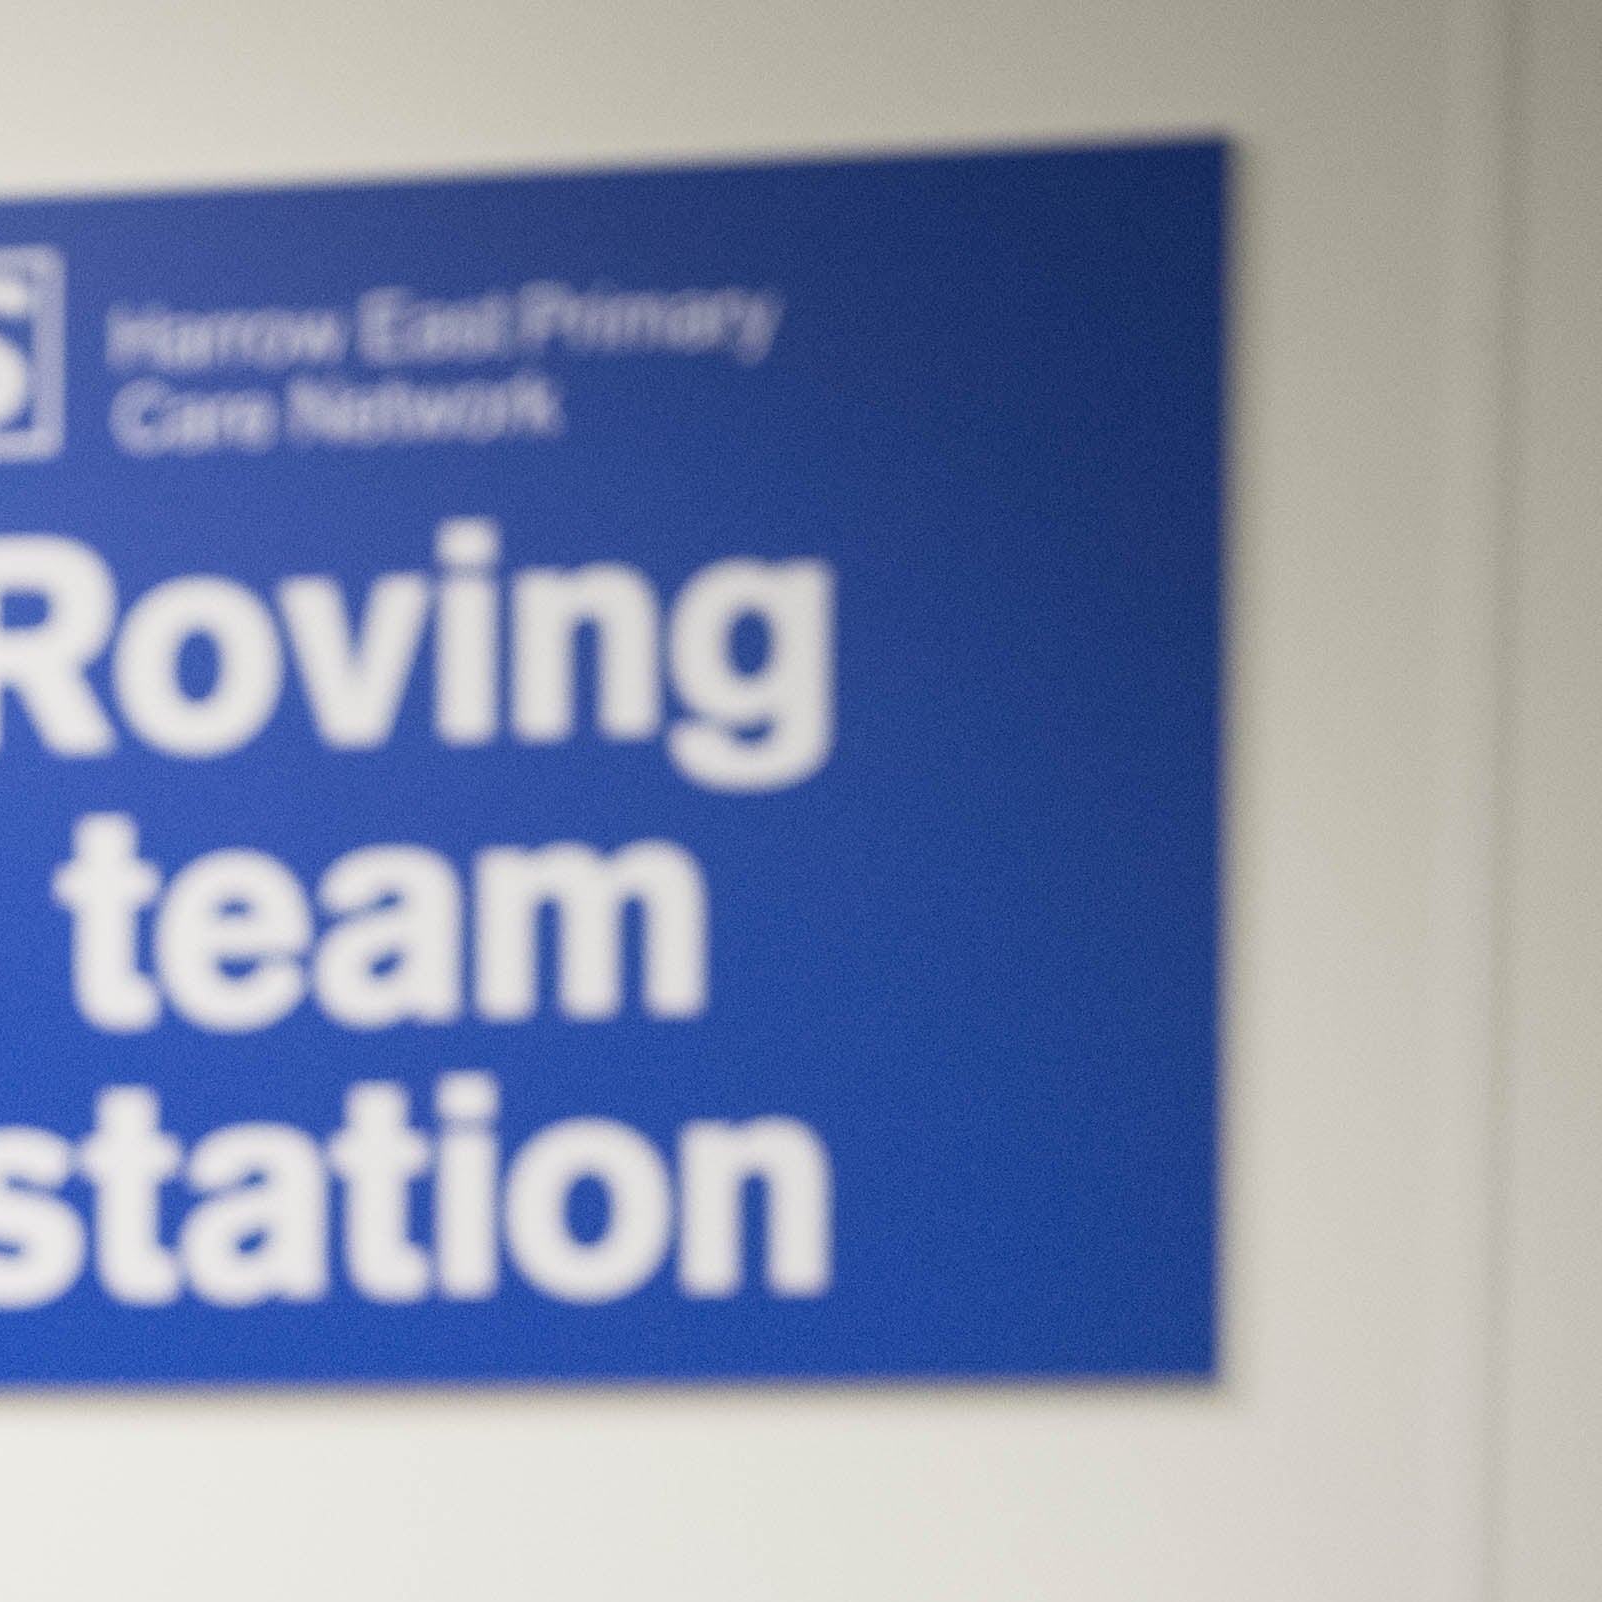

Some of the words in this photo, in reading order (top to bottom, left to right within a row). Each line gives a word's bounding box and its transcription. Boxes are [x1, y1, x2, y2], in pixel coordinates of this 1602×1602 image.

[104, 305, 344, 374] Harrow
[355, 286, 511, 364] East
[517, 280, 775, 366] Primary
[107, 377, 275, 457] Care
[281, 370, 563, 450] Network
[53, 812, 705, 1031] team
